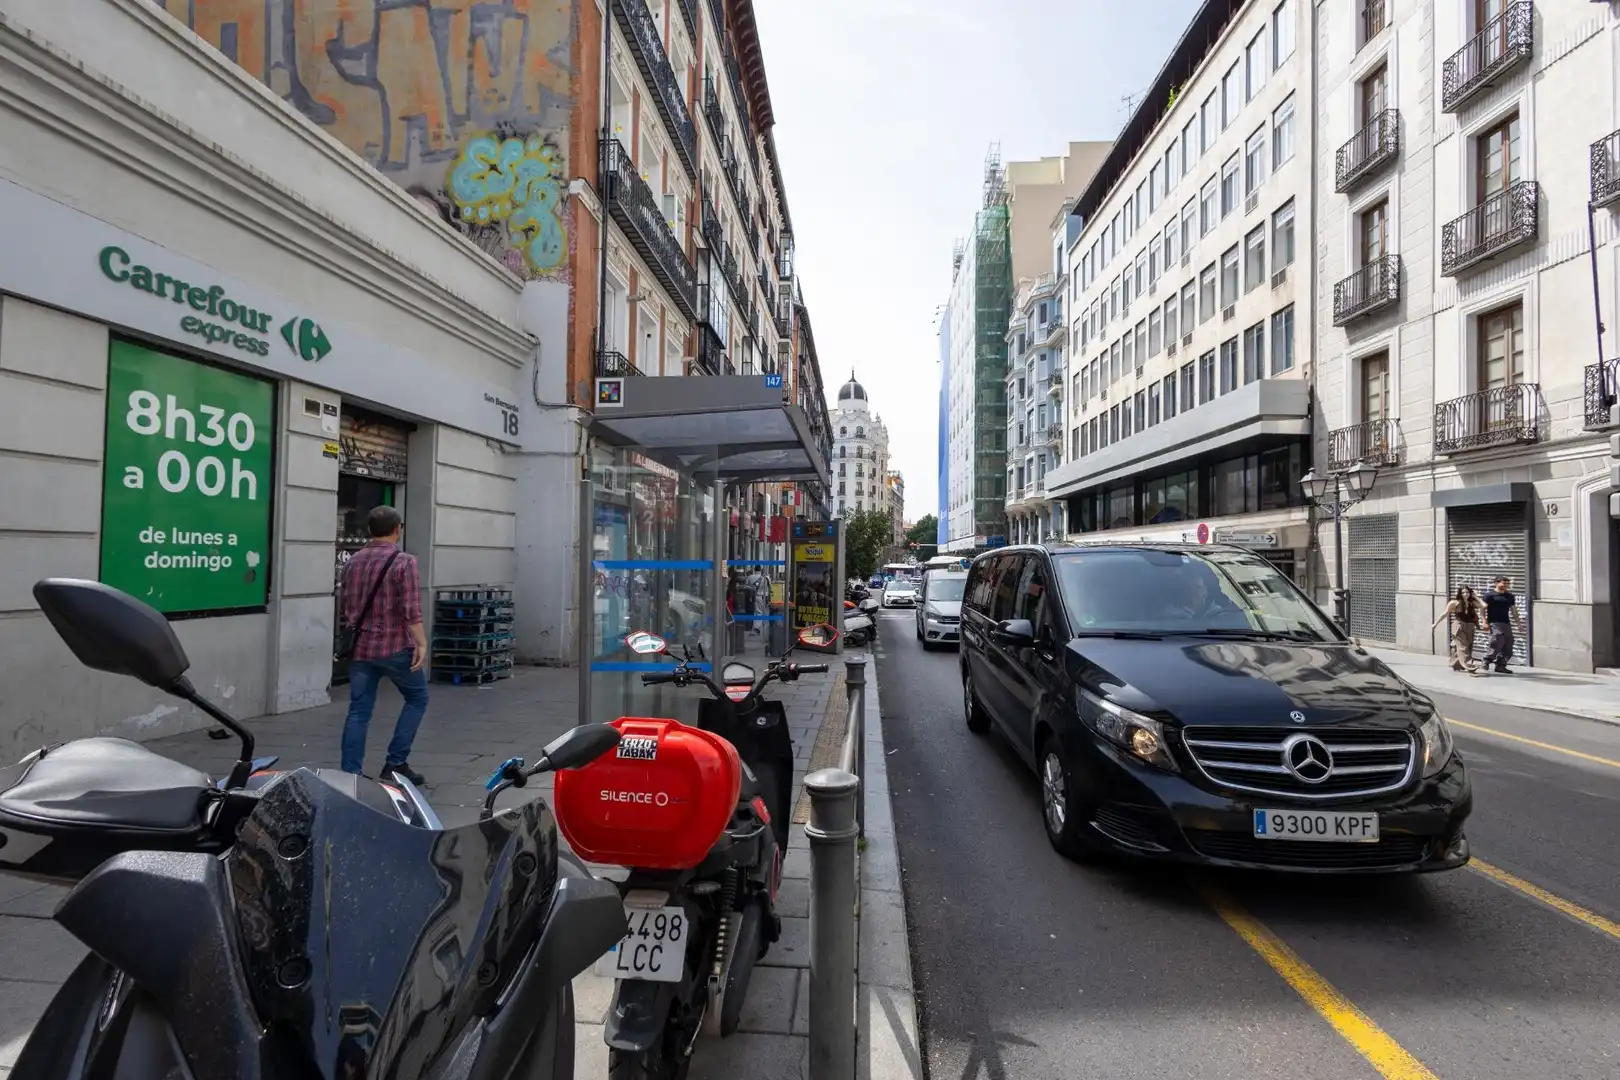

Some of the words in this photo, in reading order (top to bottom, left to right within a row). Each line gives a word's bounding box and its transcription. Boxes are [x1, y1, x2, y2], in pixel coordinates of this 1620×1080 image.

[99, 246, 272, 333] Carrefour
[180, 315, 269, 356] express
[766, 376, 781, 386] 147
[126, 390, 255, 451] 8h30
[501, 409, 519, 436] 18
[123, 465, 144, 489] a
[157, 450, 257, 500] 00h
[1546, 503, 1558, 516] 19
[139, 526, 166, 544] de
[172, 527, 223, 546] lunes
[228, 532, 238, 546] a
[144, 551, 233, 572] domingo
[618, 748, 656, 759] TABAK
[600, 790, 652, 804] SILENCE
[1272, 814, 1327, 835] 9300
[1334, 816, 1373, 836] KPF
[616, 942, 663, 972] LCC
